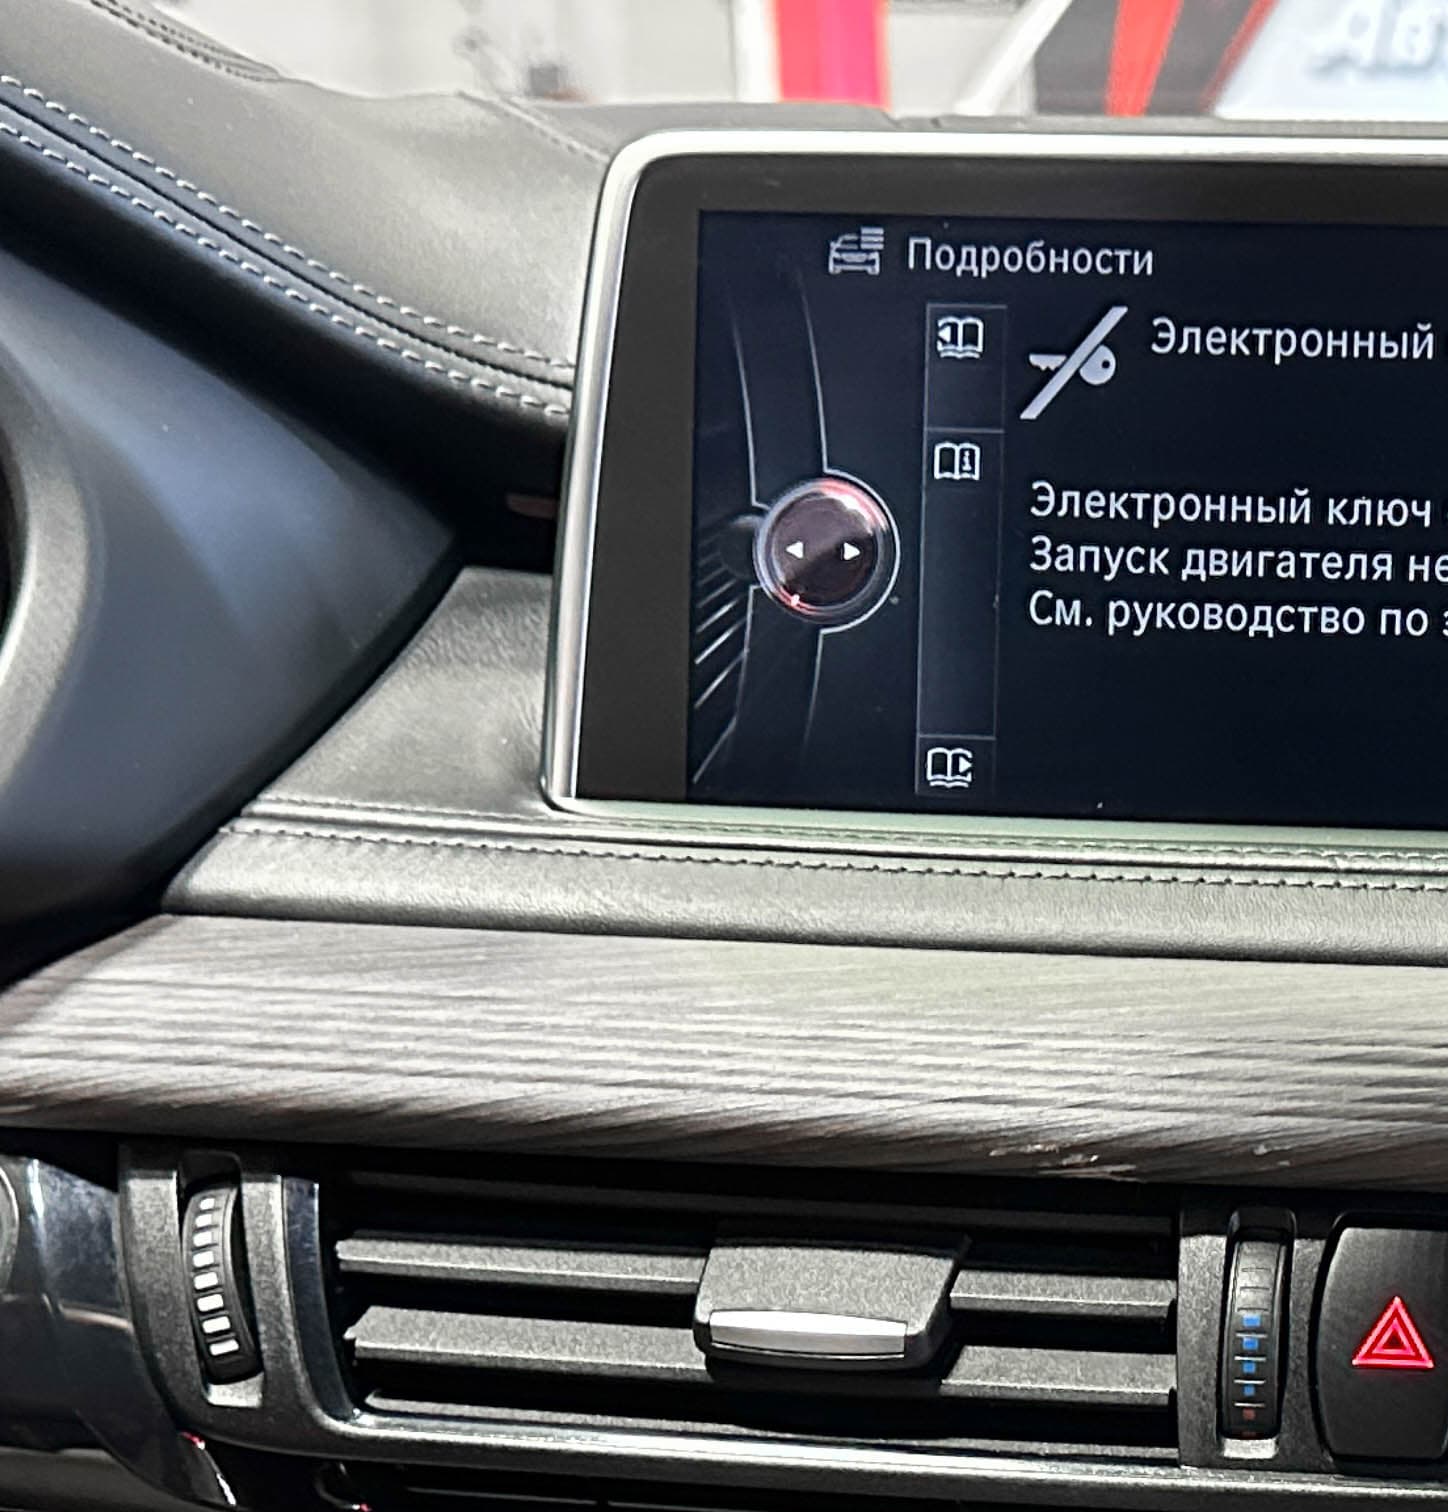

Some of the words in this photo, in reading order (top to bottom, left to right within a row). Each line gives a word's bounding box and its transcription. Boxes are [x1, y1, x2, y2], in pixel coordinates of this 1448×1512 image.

[908, 237, 1153, 279] Подробности
[1151, 317, 1434, 365] Электронный
[1030, 480, 1311, 529] Электронный
[1327, 496, 1431, 528] ключ
[1029, 534, 1170, 582] Запуск
[1181, 548, 1393, 582] двигателя
[1029, 589, 1093, 627] См.
[1108, 599, 1365, 639] руководство
[1380, 608, 1429, 637] по
